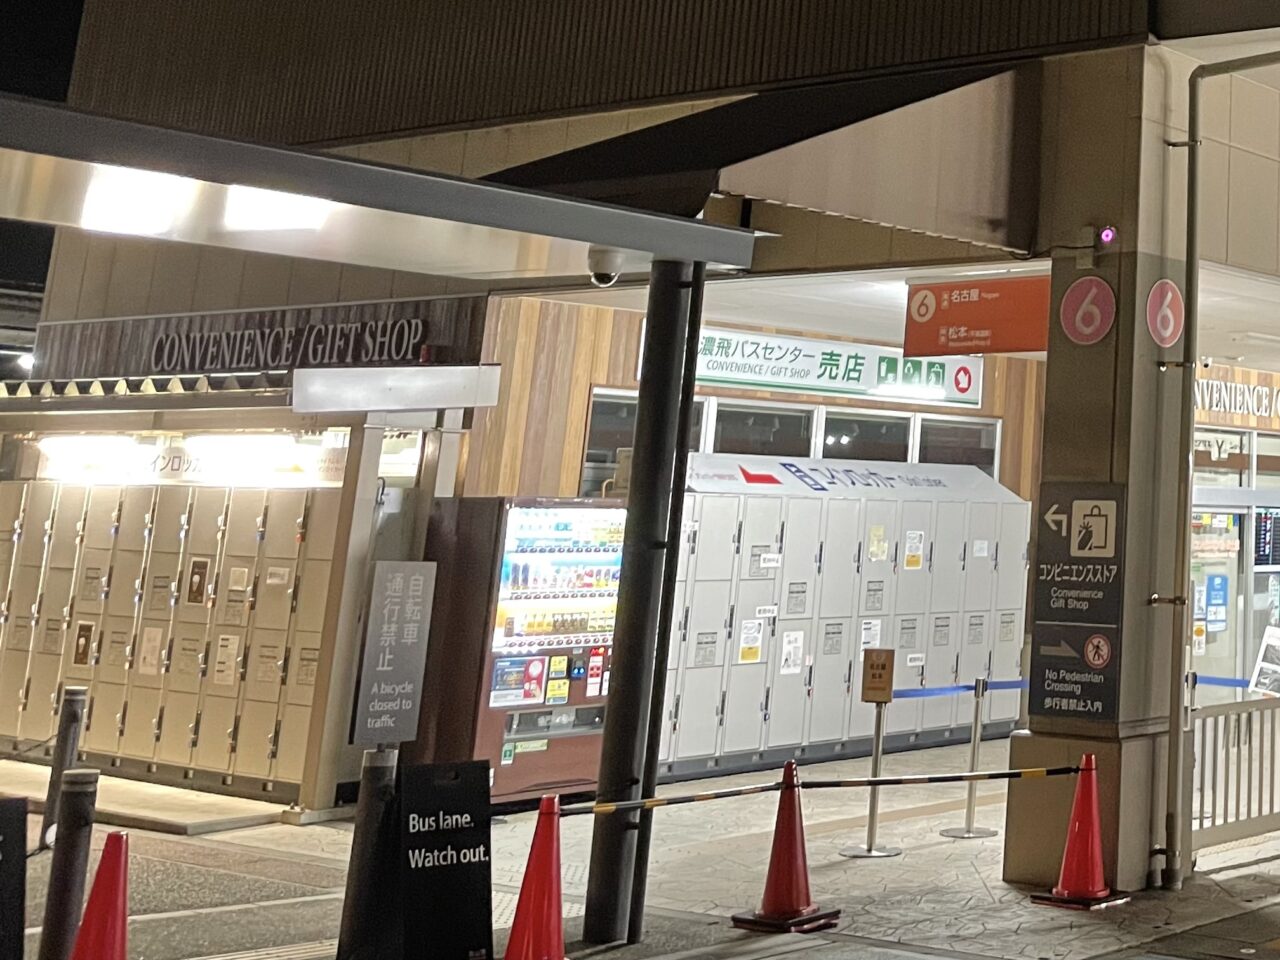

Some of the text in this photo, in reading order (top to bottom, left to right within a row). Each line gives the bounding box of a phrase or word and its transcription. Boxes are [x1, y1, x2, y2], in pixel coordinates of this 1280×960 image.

[916, 293, 929, 317] 6
[950, 288, 980, 302] 名古屋
[1075, 286, 1101, 335] 6
[1157, 290, 1175, 338] 6
[151, 327, 296, 372] CONVENIENCE
[308, 322, 361, 365] GIFT
[361, 319, 423, 361] SHOP
[697, 335, 866, 383] 濃飛バスセンター 売店
[706, 359, 765, 374] CONVENIENCE
[770, 366, 789, 378] GIFT
[789, 367, 811, 379] SHOP
[1039, 563, 1118, 584] コンビニエンスストア
[1051, 587, 1104, 599] Convenience
[401, 573, 425, 646] 自転車
[1050, 598, 1089, 611] Gift Shop
[375, 572, 404, 671] 通行禁止
[1045, 668, 1104, 684] No Pedestrian
[370, 681, 414, 696] A bicycle
[1044, 680, 1081, 695] Crossing
[369, 698, 412, 712] closed to
[367, 714, 396, 729] traffic
[409, 810, 475, 833] Bus lane.
[408, 844, 489, 869] Watch out.
